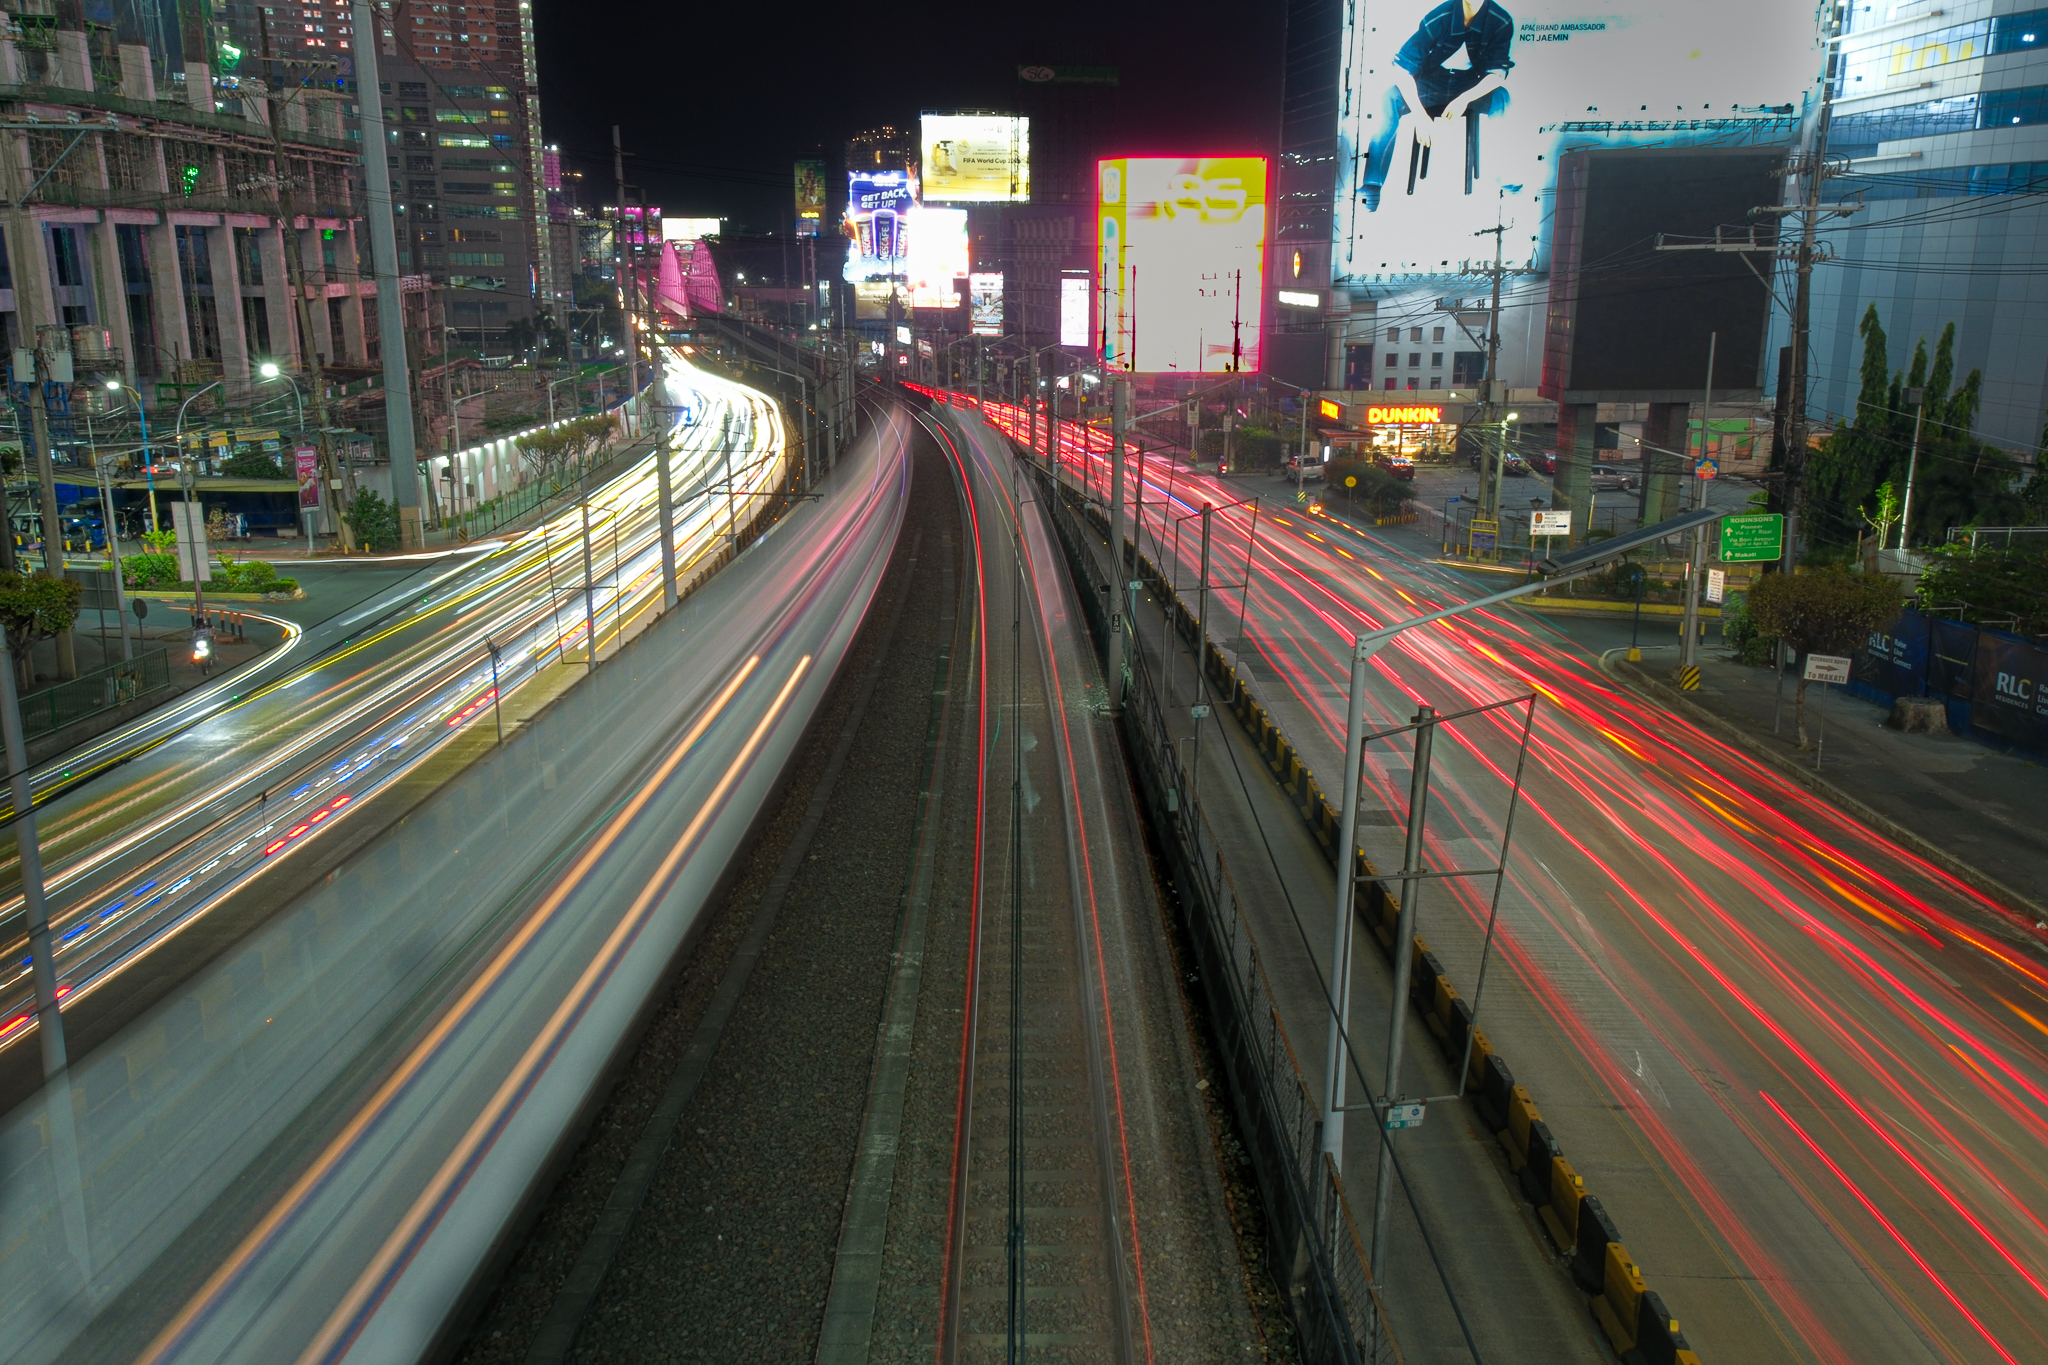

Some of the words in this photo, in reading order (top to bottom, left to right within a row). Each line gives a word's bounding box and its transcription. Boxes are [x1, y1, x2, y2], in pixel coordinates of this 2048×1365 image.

[1536, 34, 1569, 42] JAEMIN
[861, 193, 880, 202] GET
[881, 188, 907, 200] BACK,
[881, 200, 897, 208] UP!
[1894, 638, 1907, 649] Raise
[1893, 648, 1903, 657] Live
[1892, 656, 1912, 670] Connect
[1817, 673, 1845, 682] MAKATI
[1996, 671, 2031, 700] RLC
[1995, 694, 2028, 709] RESIDENCES
